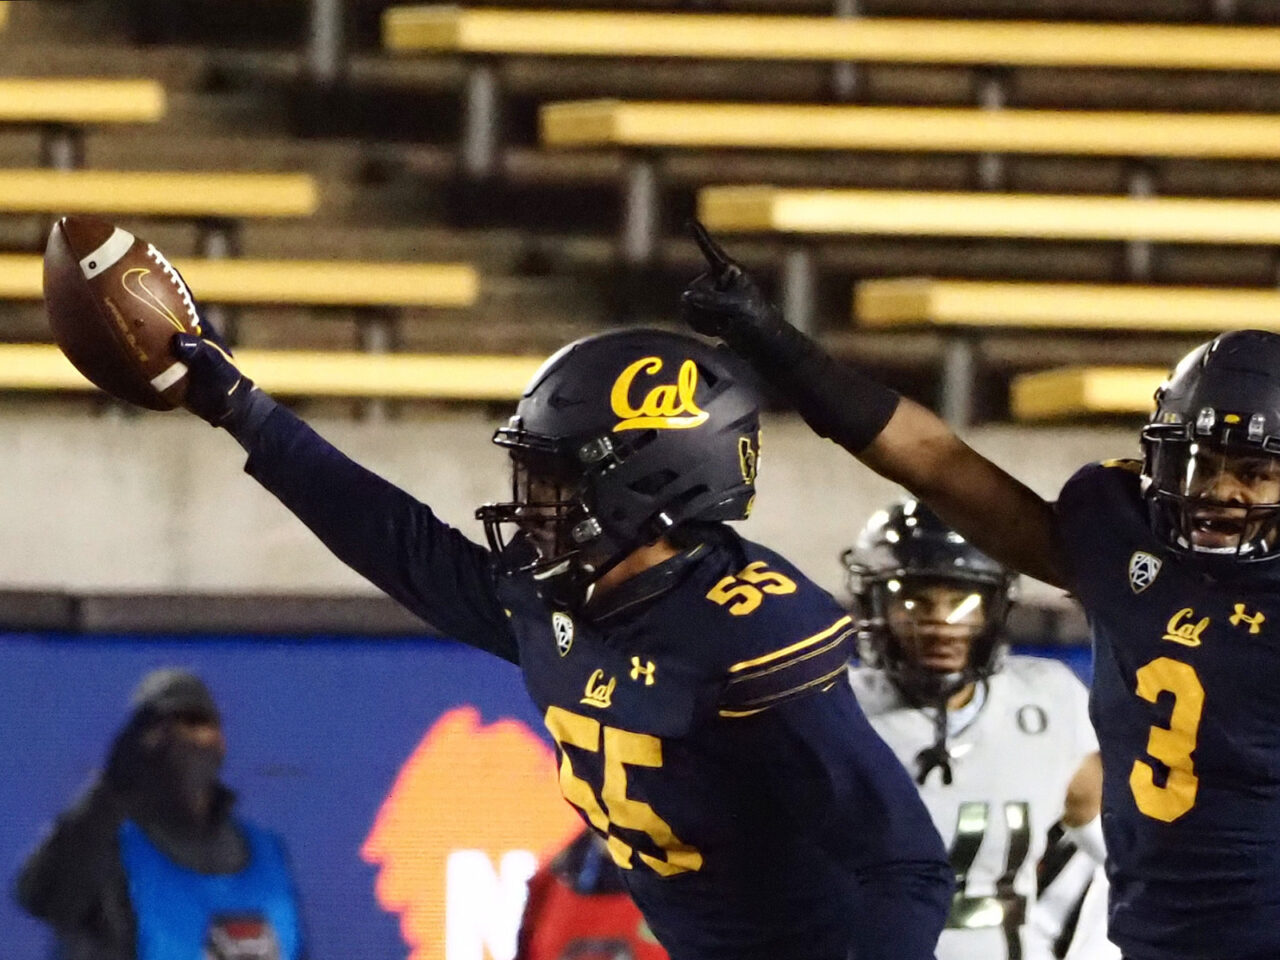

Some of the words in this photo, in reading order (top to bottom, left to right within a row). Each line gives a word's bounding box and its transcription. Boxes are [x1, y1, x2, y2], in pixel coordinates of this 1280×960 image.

[611, 357, 710, 432] Cal
[706, 561, 798, 616] 55
[1162, 608, 1210, 647] Cal
[579, 668, 617, 708] Cal
[1129, 656, 1206, 824] 3
[544, 705, 704, 878] 55
